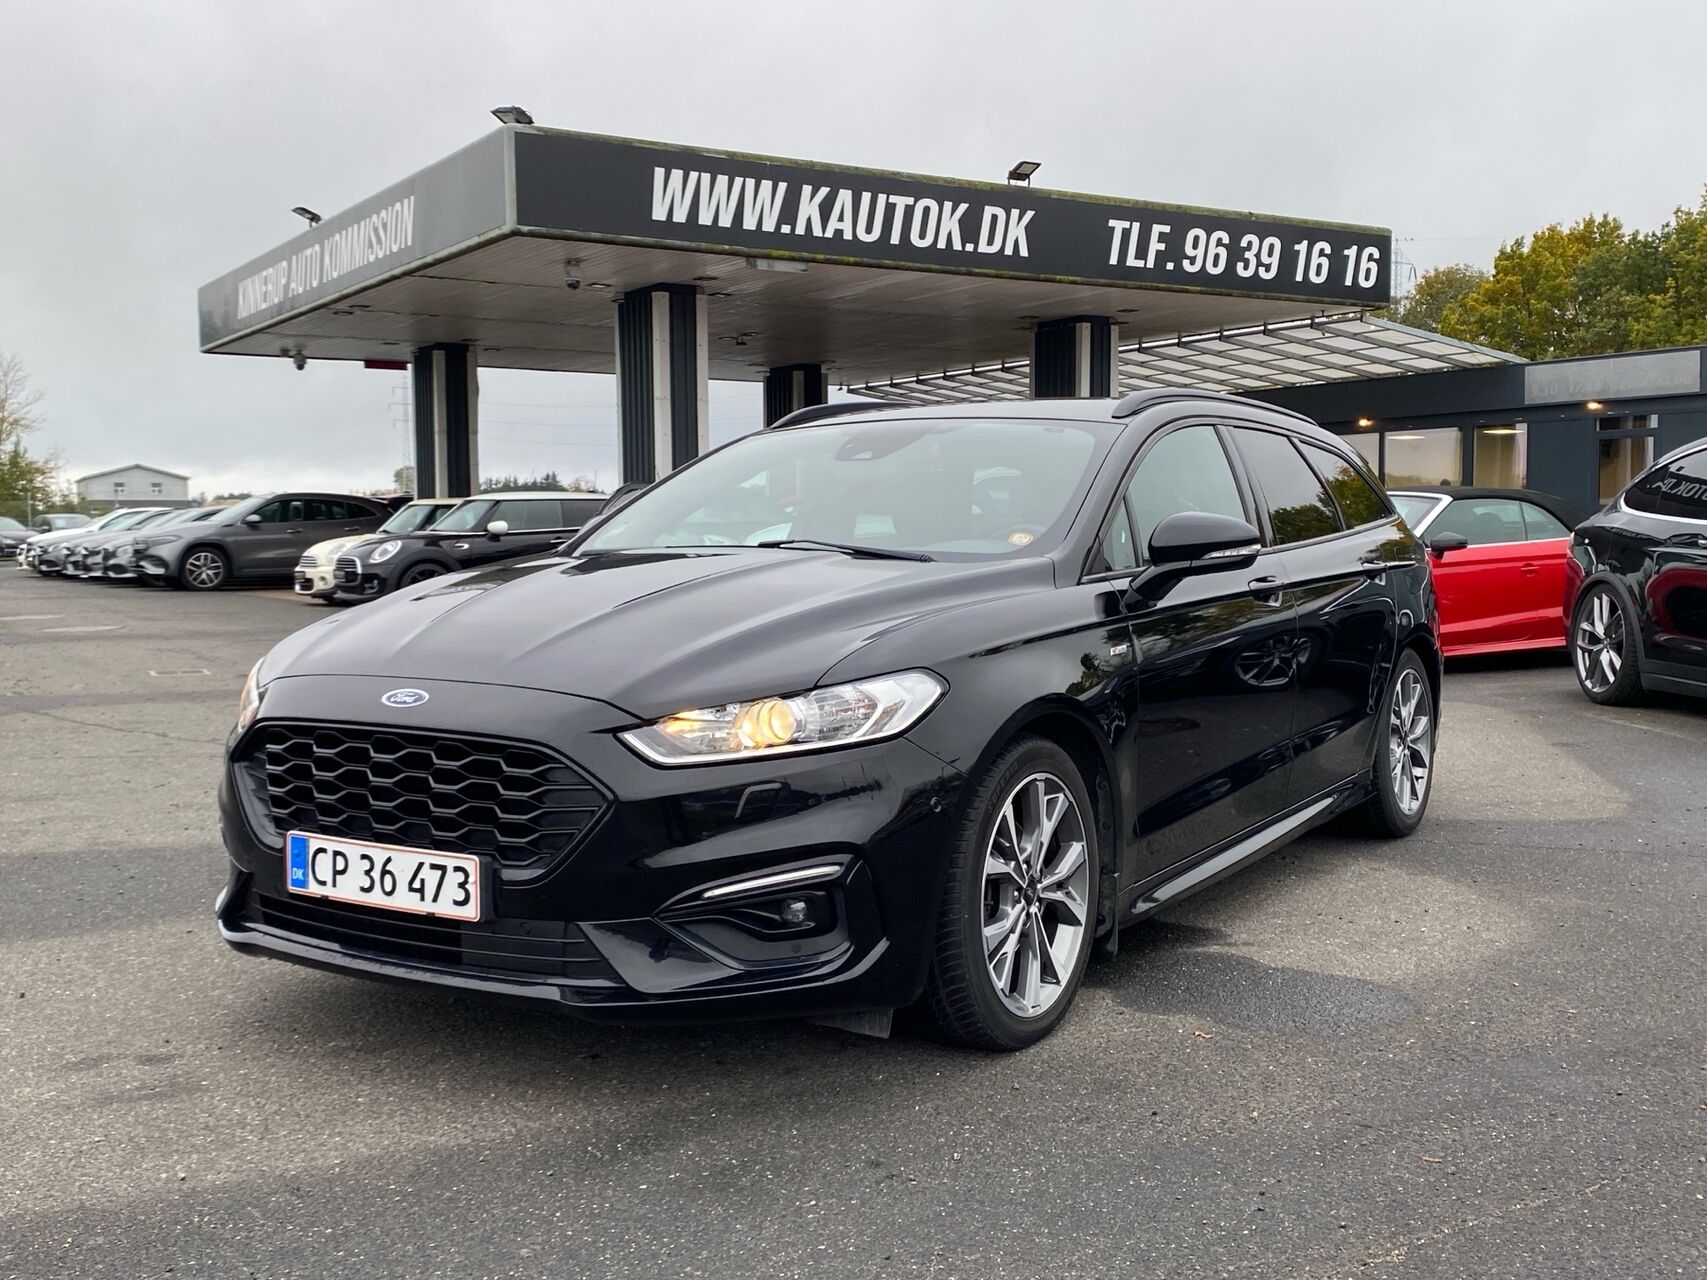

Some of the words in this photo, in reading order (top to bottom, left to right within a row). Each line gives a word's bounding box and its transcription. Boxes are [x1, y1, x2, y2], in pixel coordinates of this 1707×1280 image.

[650, 166, 1036, 258] WWW.KAUTOK.DK
[237, 260, 288, 319] KINNERUP
[289, 243, 321, 298] AUTO
[322, 195, 415, 283] KOMMISSION
[1107, 218, 1175, 271] TLF.
[1182, 227, 1230, 276] 96
[1236, 233, 1282, 281] 39
[1294, 239, 1332, 285] 16
[1343, 244, 1381, 289] 16
[292, 867, 304, 880] DK
[310, 846, 349, 888] CP
[359, 853, 397, 897] 36
[408, 861, 471, 907] 473
